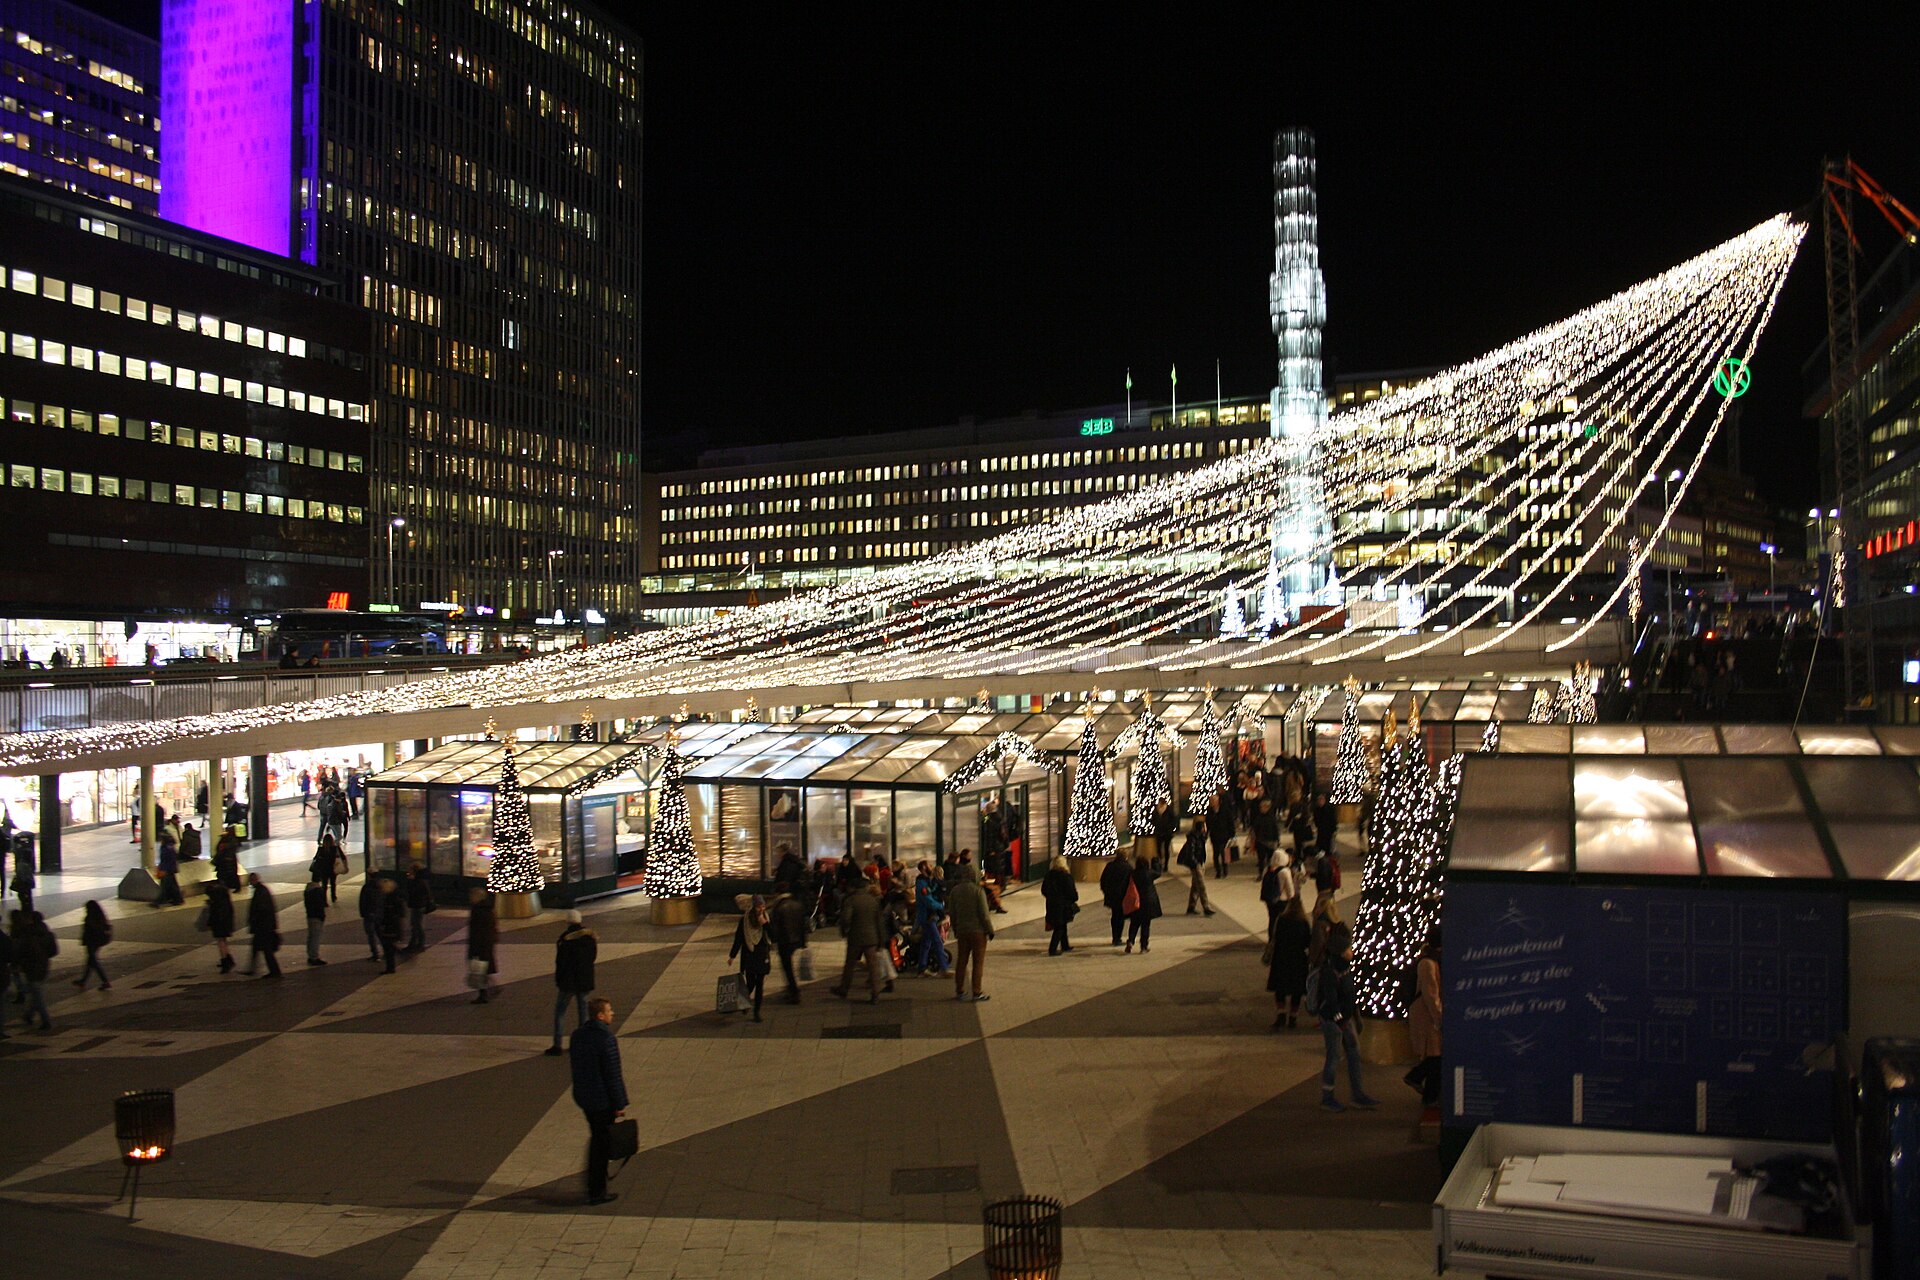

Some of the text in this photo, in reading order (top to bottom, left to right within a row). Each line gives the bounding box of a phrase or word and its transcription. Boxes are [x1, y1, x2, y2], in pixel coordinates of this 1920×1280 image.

[1080, 417, 1114, 436] SEB
[1461, 935, 1564, 961] Julmarknad
[1454, 1239, 1595, 1264] Volkswagen Transporter
